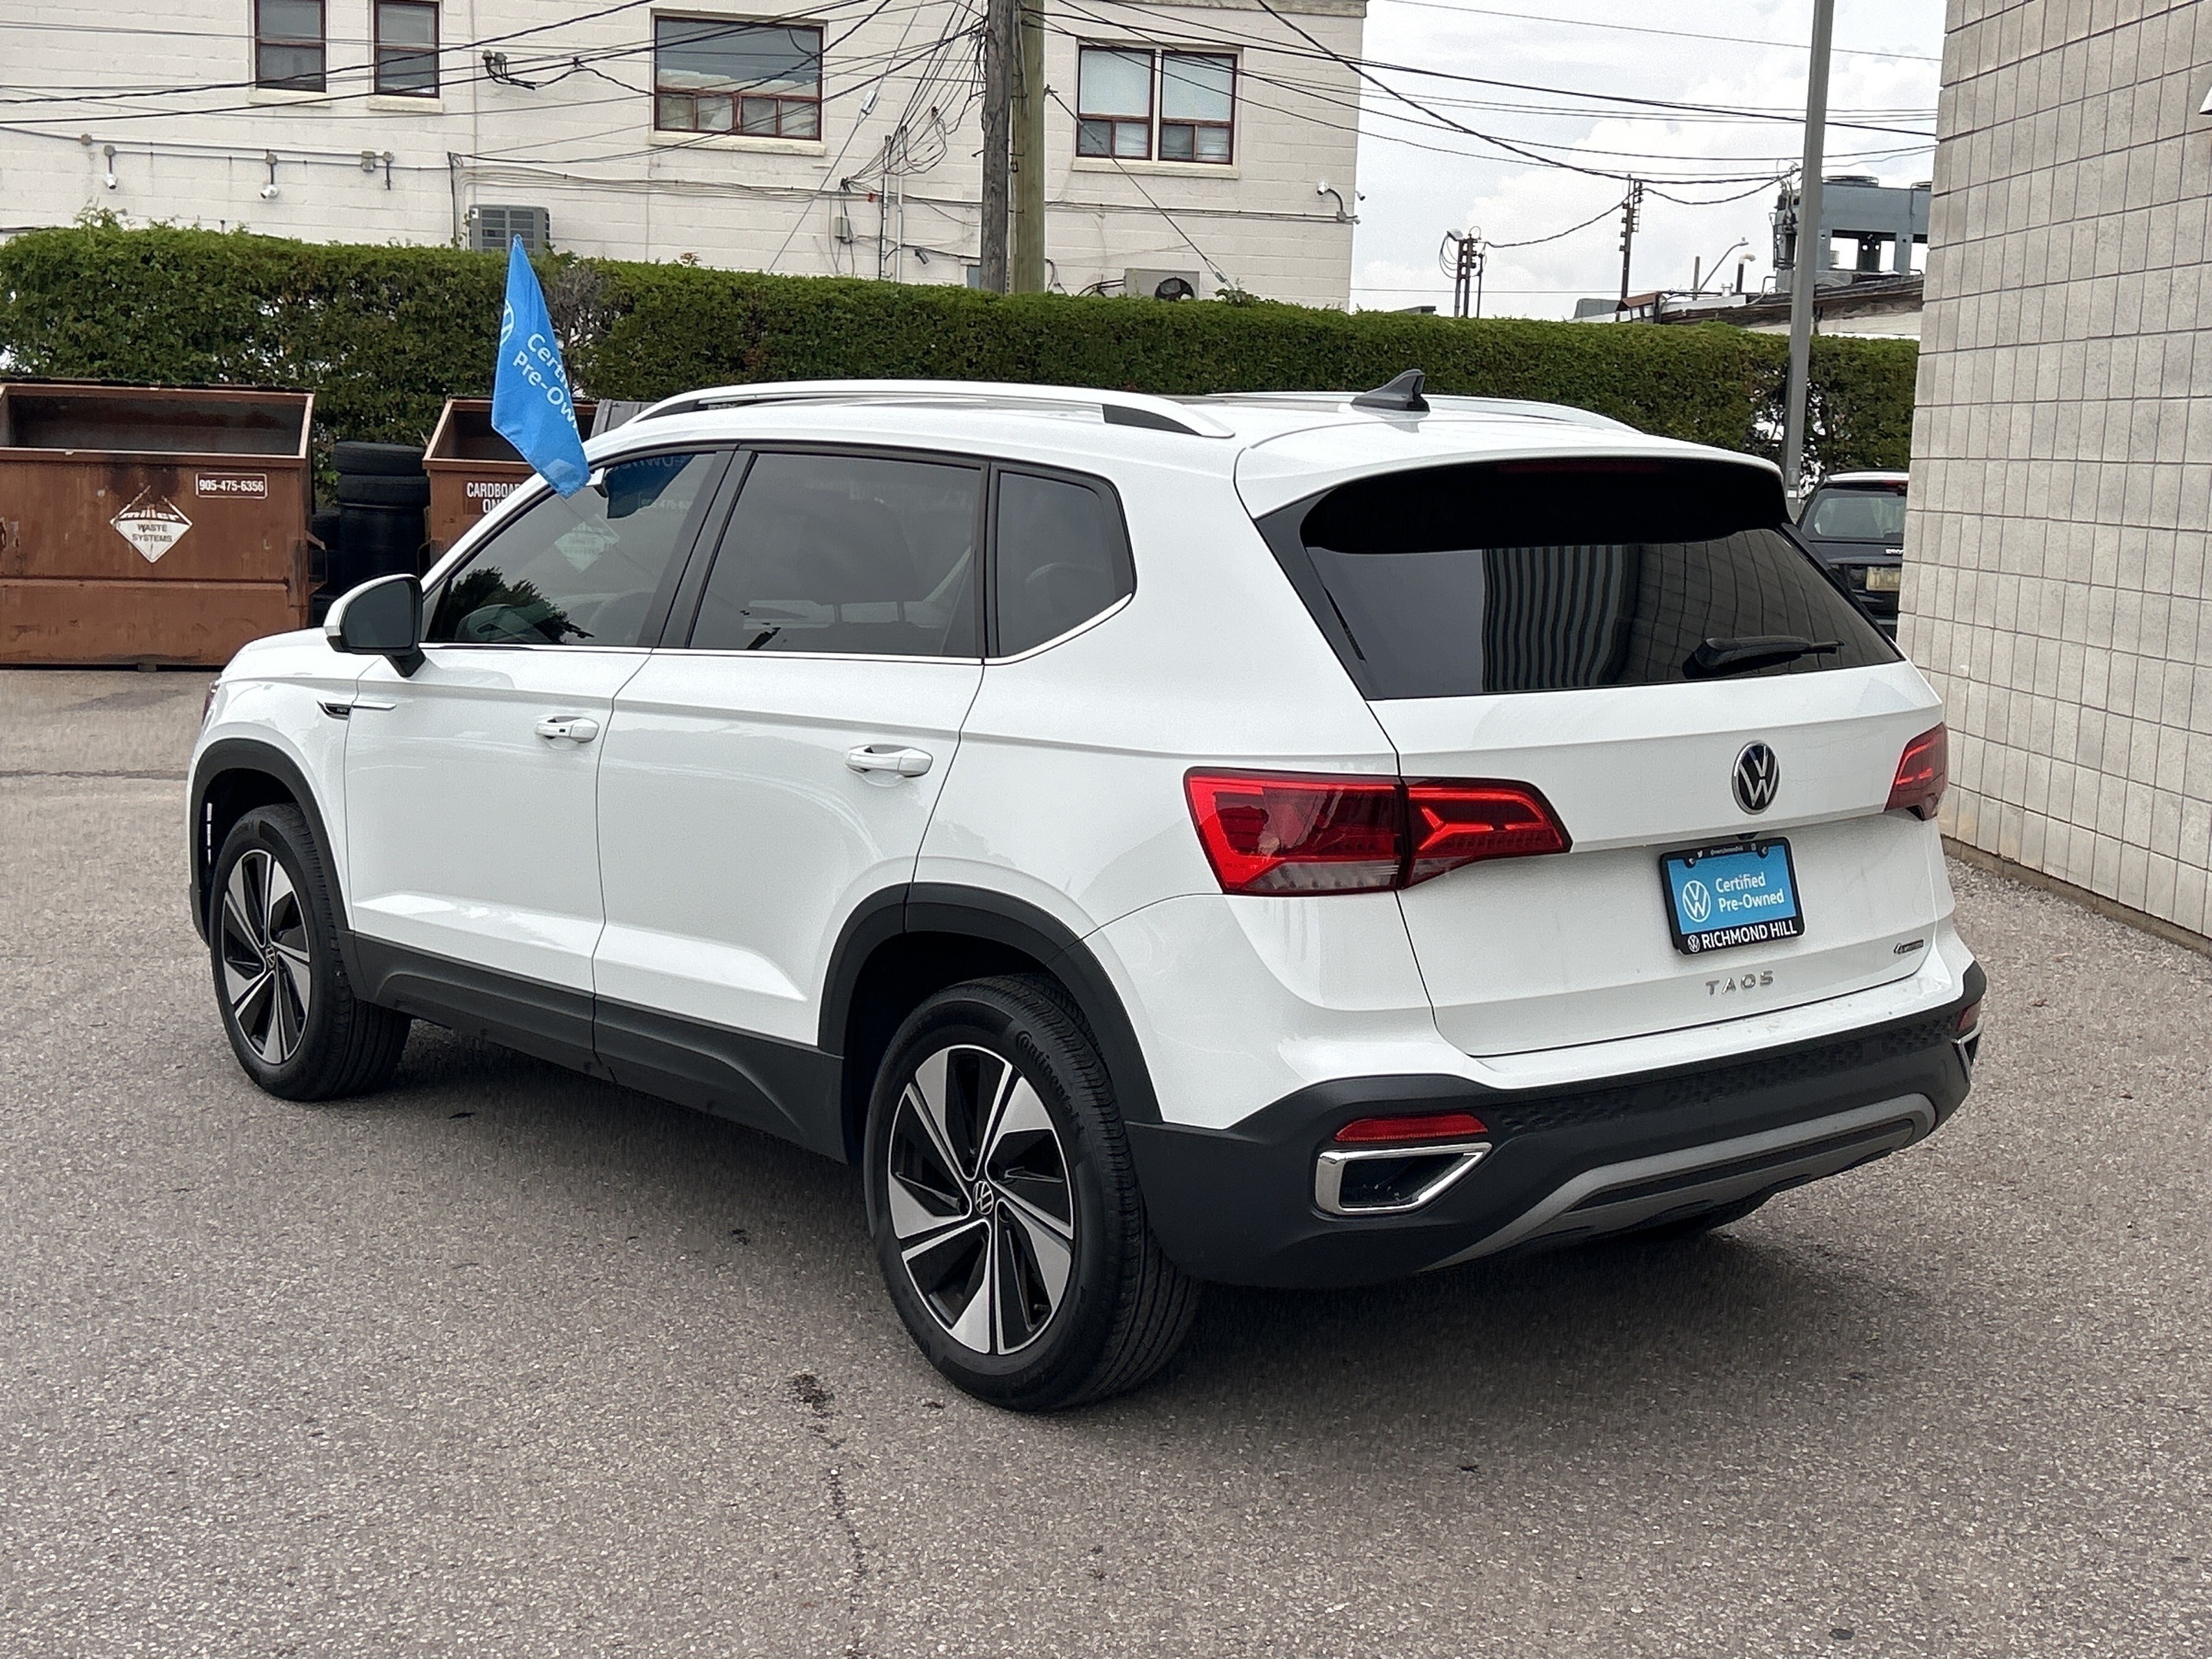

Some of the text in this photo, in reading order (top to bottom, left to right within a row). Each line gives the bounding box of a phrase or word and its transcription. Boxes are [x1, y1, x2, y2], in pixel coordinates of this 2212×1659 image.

[199, 479, 264, 492] 905-475-6356
[466, 482, 521, 498] CARDBOA
[131, 533, 173, 542] SYSTEMS
[137, 523, 167, 533] WASTE
[1715, 871, 1767, 893] Certified
[1717, 888, 1785, 913] Pre-Owned
[1701, 924, 1767, 949] RICHMOND
[1769, 919, 1797, 938] HILL
[1705, 969, 1773, 996] TAOS
